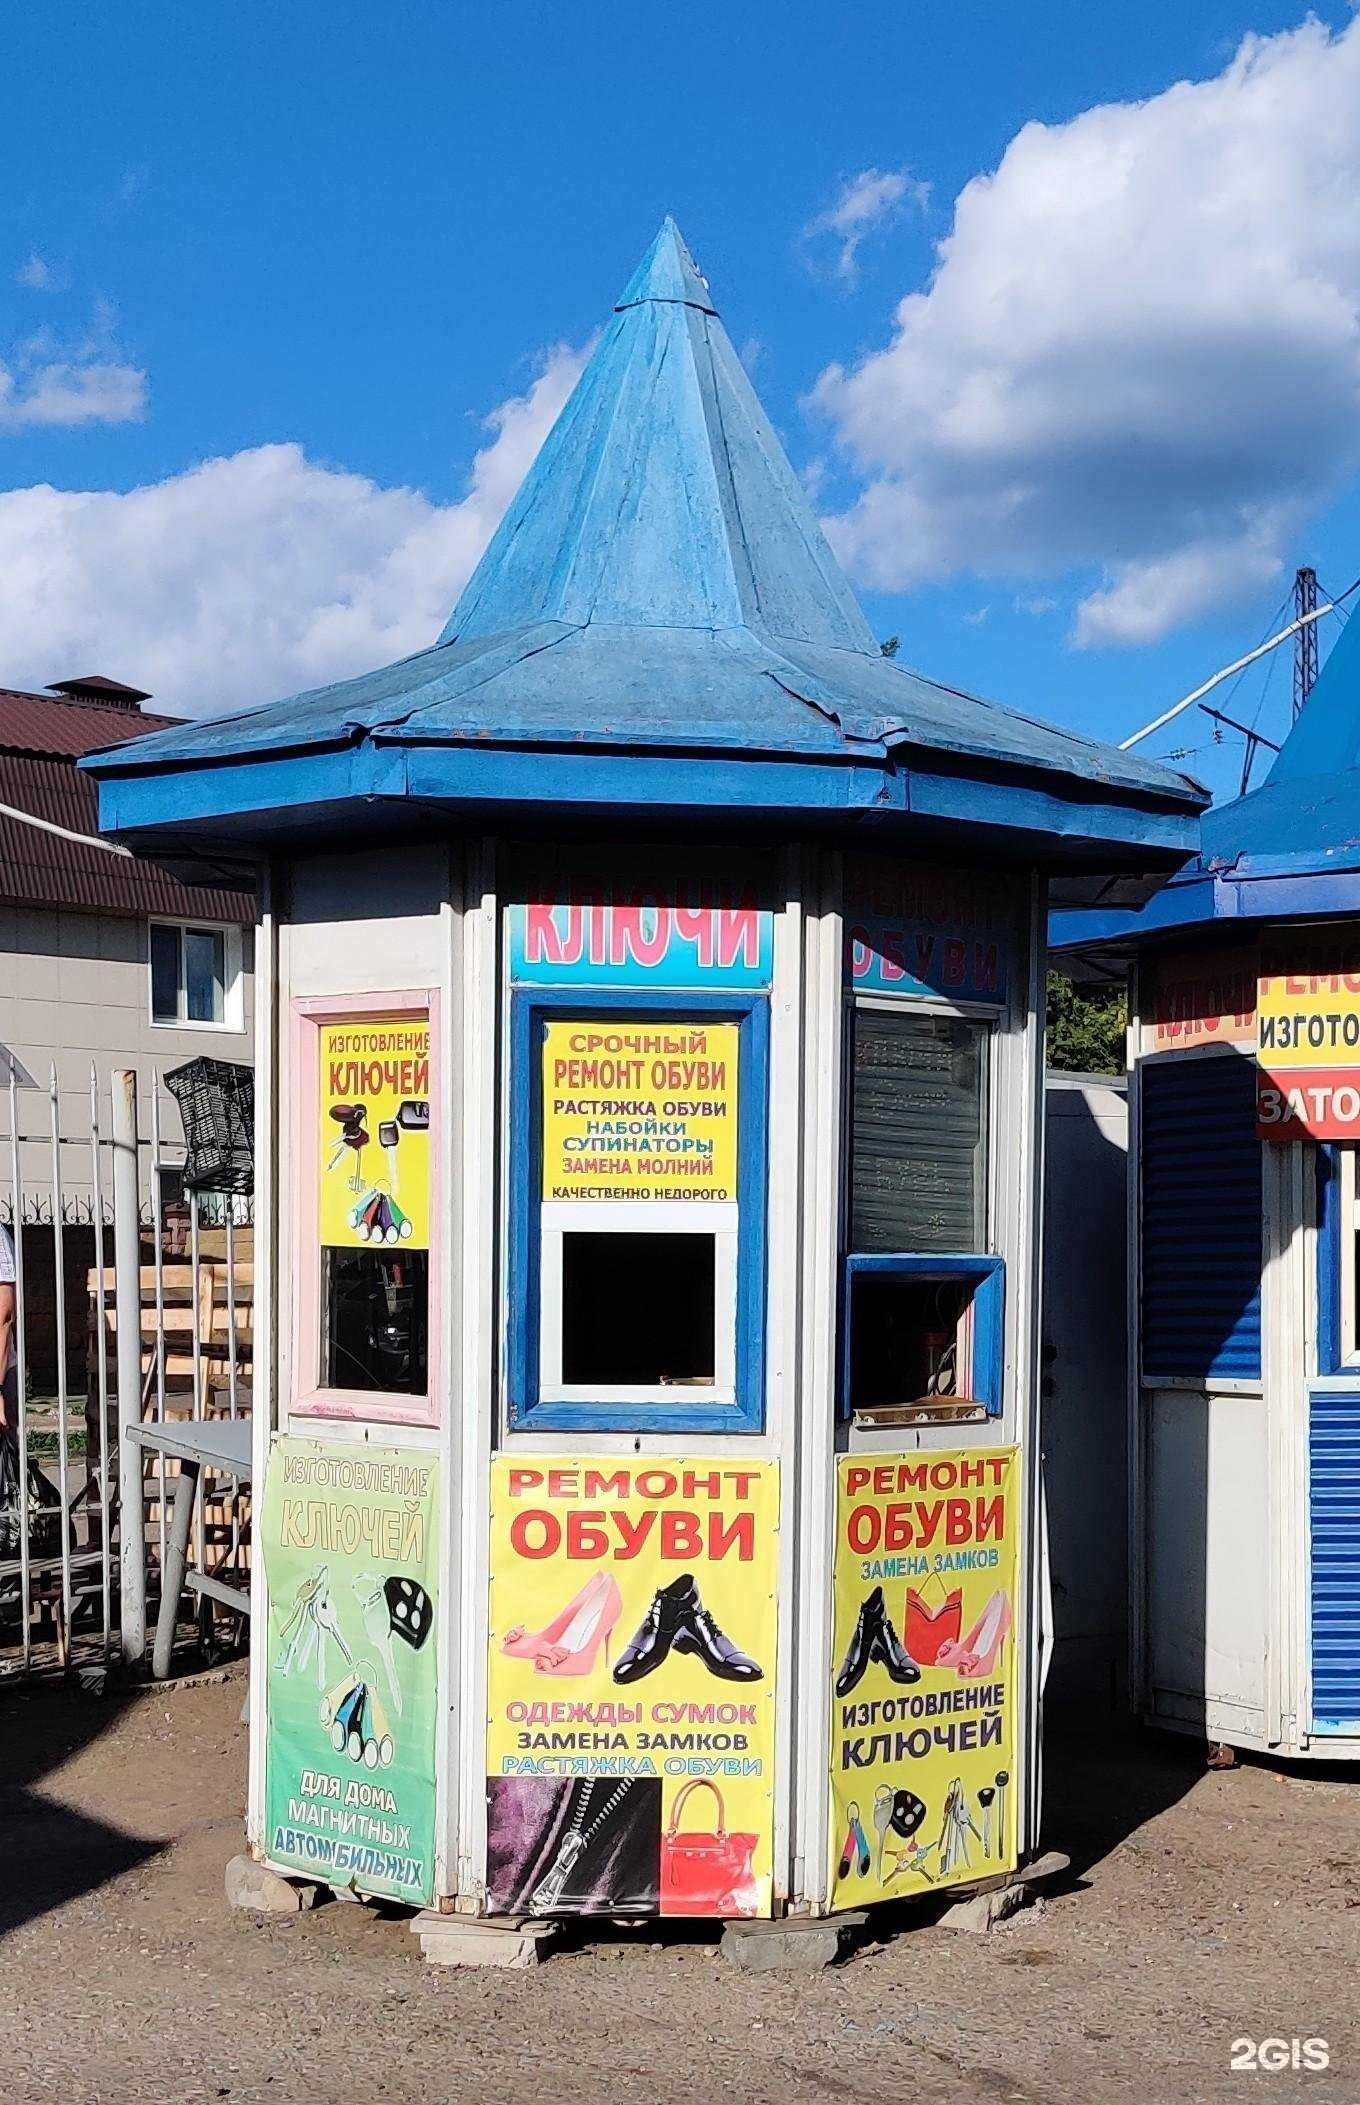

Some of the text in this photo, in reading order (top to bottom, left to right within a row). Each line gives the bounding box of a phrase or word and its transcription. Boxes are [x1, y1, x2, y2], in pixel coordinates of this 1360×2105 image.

[524, 877, 761, 968] КЛЮЧИ
[847, 924, 999, 992] ОБУВИ
[329, 1032, 430, 1053] ИЗГОТОВЛЕНИЕ
[569, 1032, 707, 1055] СРОЧНЫЙ
[330, 1052, 429, 1095] КЛЮЧЕЙ
[554, 1060, 726, 1091] РЕМОНТ ОБУВИ
[554, 1100, 727, 1117] РАСТЯЖКА ОБУВИ
[1258, 1087, 1360, 1124] ЗАТО
[563, 1137, 714, 1154] СУПИНАТОРЫ
[586, 1118, 686, 1136] НАБОЙКИ
[562, 1155, 713, 1176] ЗАМЕНА МОЛНИЙ
[552, 1187, 728, 1201] КАЧЕСТВЕННО НЕДОРОГО
[283, 1456, 428, 1497] ИЗГОТОВЛЕНИЕ
[508, 1470, 761, 1500] РЕМОНТ
[846, 1456, 1011, 1497] РЕМОНТ
[280, 1499, 425, 1563] КЛЮЧЕЙ
[510, 1509, 754, 1561] ОБУВИ
[847, 1495, 1005, 1554] ОБУВИ
[860, 1547, 1000, 1581] ЗАМЕНА ЗАМКОВ
[506, 1702, 757, 1725] ОДЕЖДЫ СУМОК
[842, 1682, 1005, 1729] ИЗГОТОВЛЕНИЕ
[517, 1732, 748, 1752] ЗАМЕНА ЗАМКОВ
[842, 1709, 1003, 1770] КЛЮЧЕЙ
[502, 1756, 763, 1777] РАСТЯЖКА ОБУВИ
[300, 1770, 399, 1815] ДЛЯ ДОМА
[288, 1798, 412, 1850] МАГНИТНЫХ
[273, 1826, 424, 1887] АВТОМБИЛЬНЫХ
